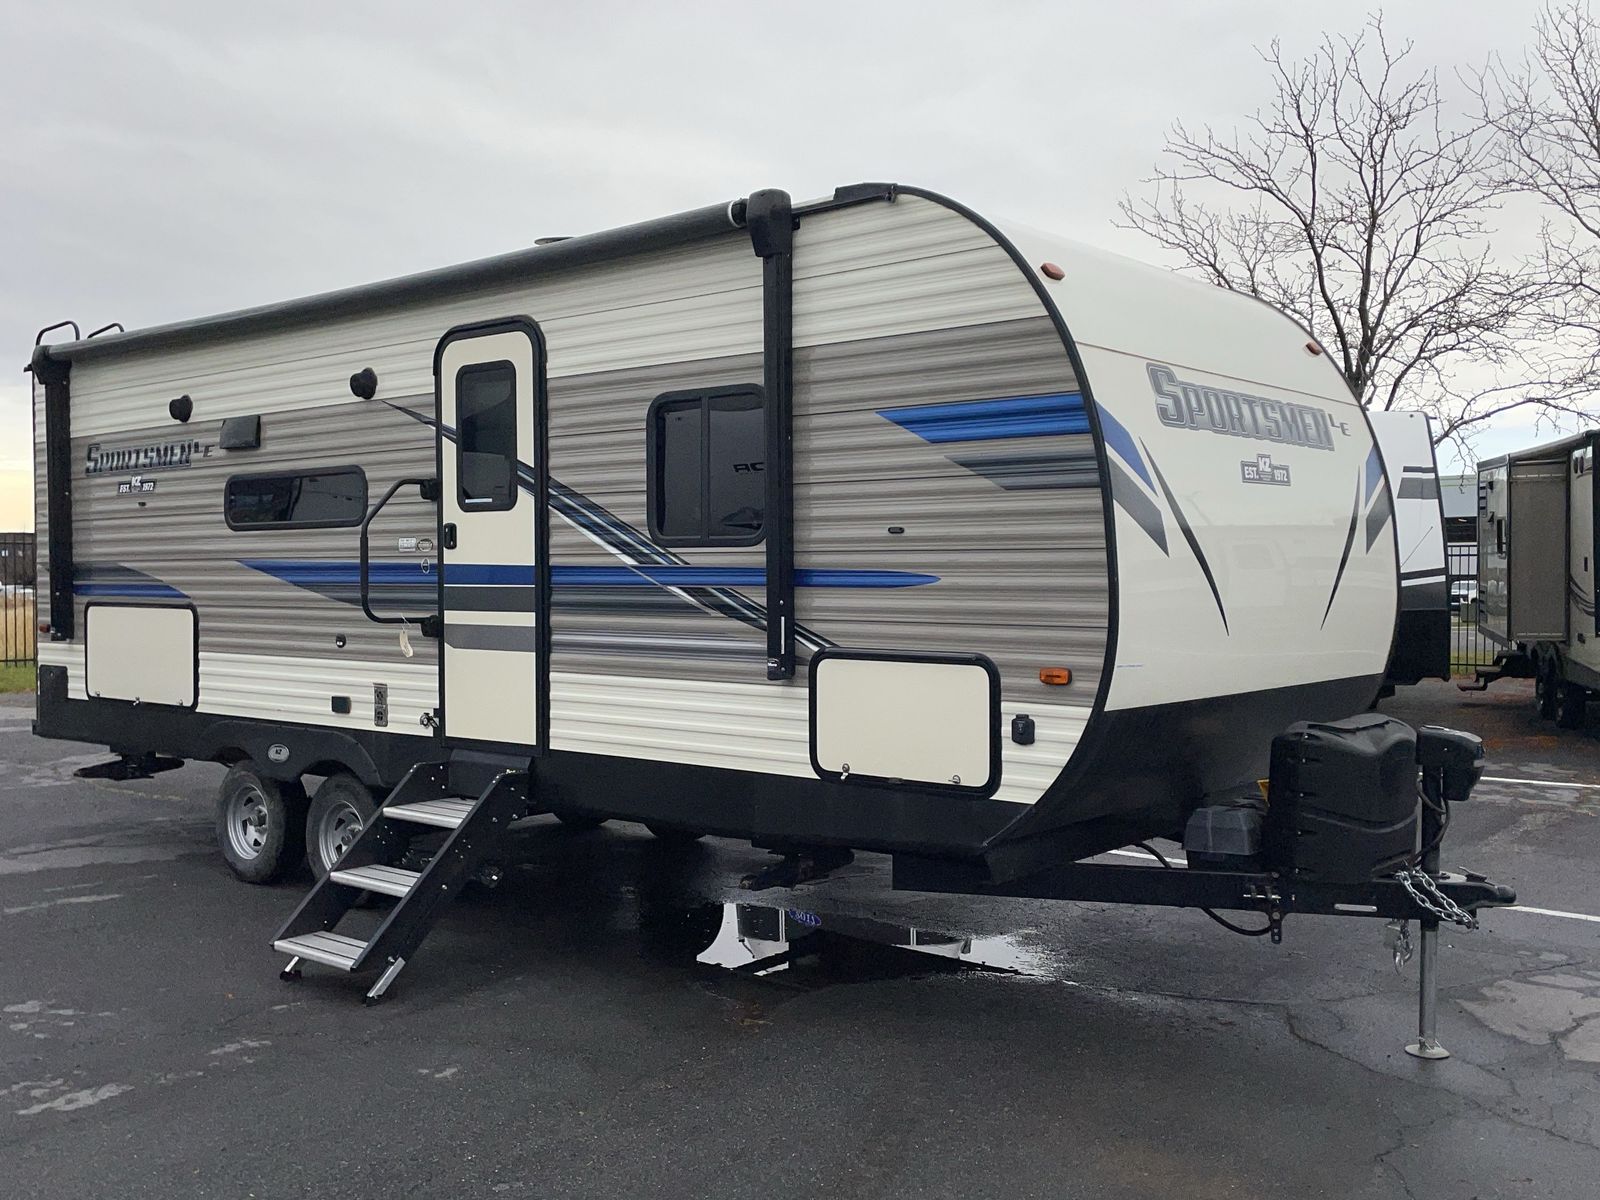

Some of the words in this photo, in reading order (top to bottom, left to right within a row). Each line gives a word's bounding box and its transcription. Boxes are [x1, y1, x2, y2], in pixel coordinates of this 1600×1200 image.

[1146, 362, 1335, 451] SPORTSMEN
[1258, 456, 1271, 472] KZ
[1244, 465, 1260, 479] EST.
[1273, 469, 1288, 481] 1972
